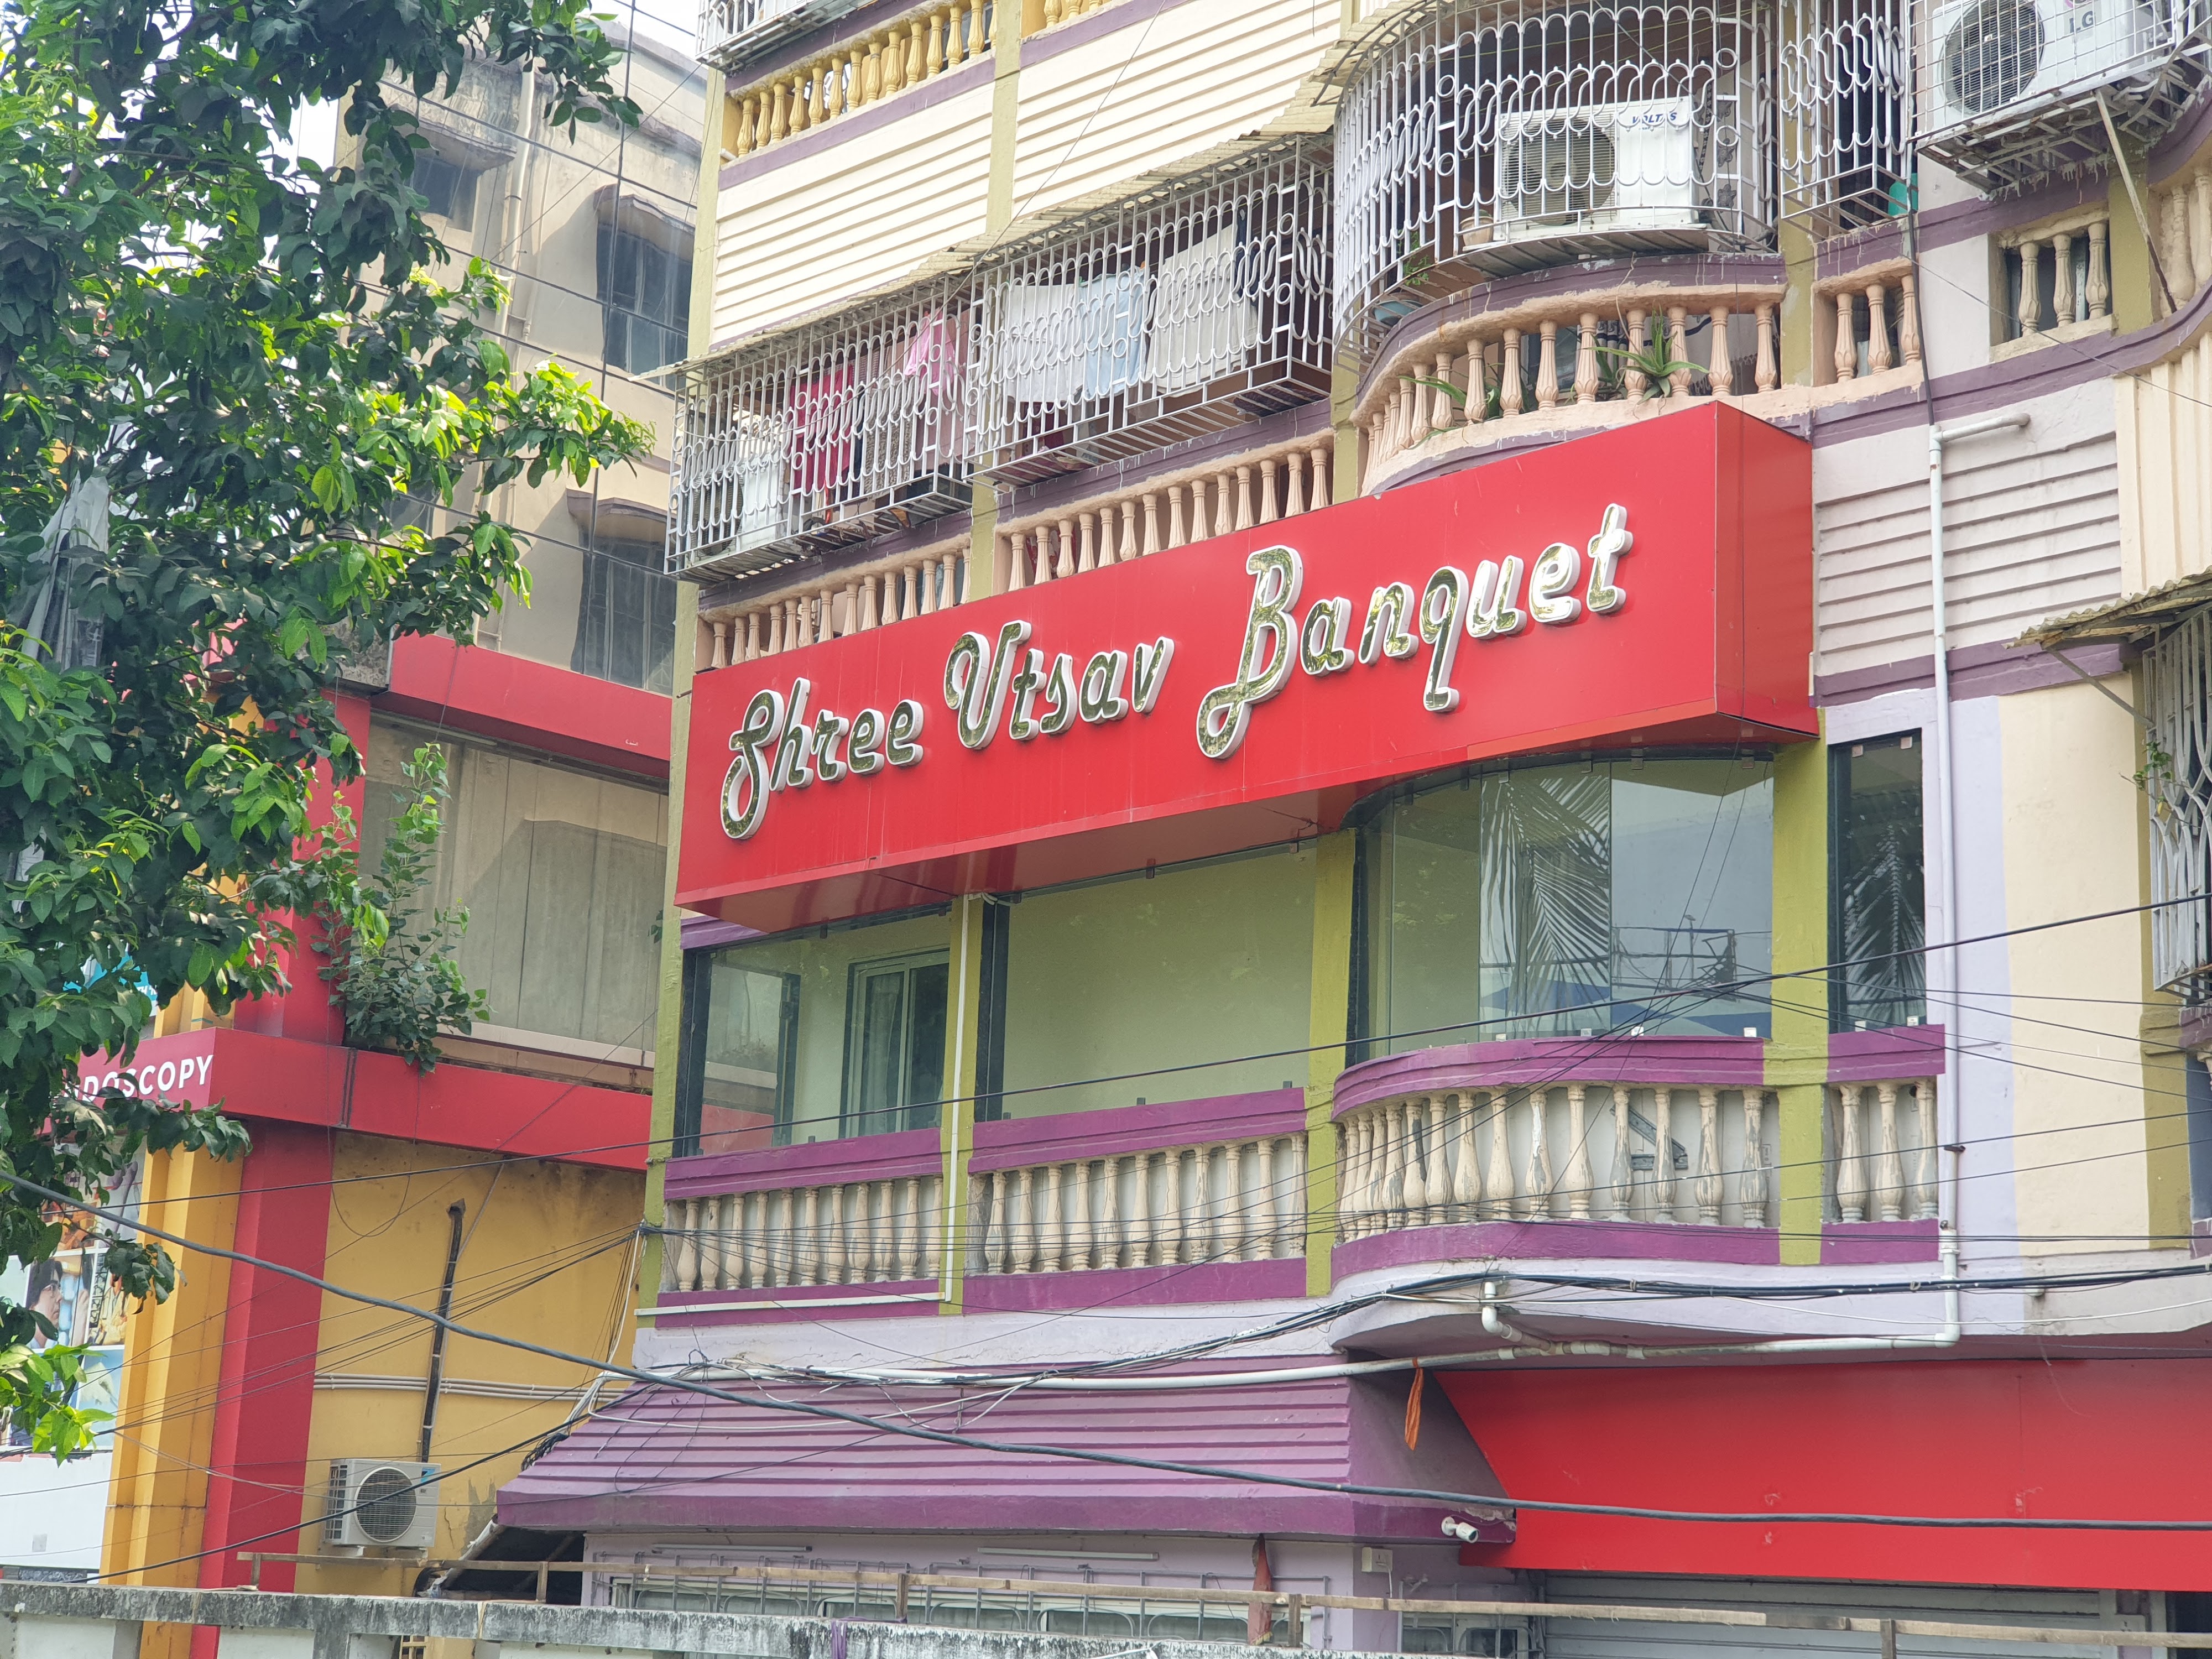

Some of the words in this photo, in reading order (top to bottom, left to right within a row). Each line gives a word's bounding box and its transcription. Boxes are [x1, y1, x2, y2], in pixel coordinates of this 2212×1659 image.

[2069, 11, 2096, 33] LG
[1632, 112, 1677, 124] VOLTS
[720, 677, 924, 839] Shree
[943, 620, 1175, 749] Utsav
[1196, 503, 1633, 759] Banquet
